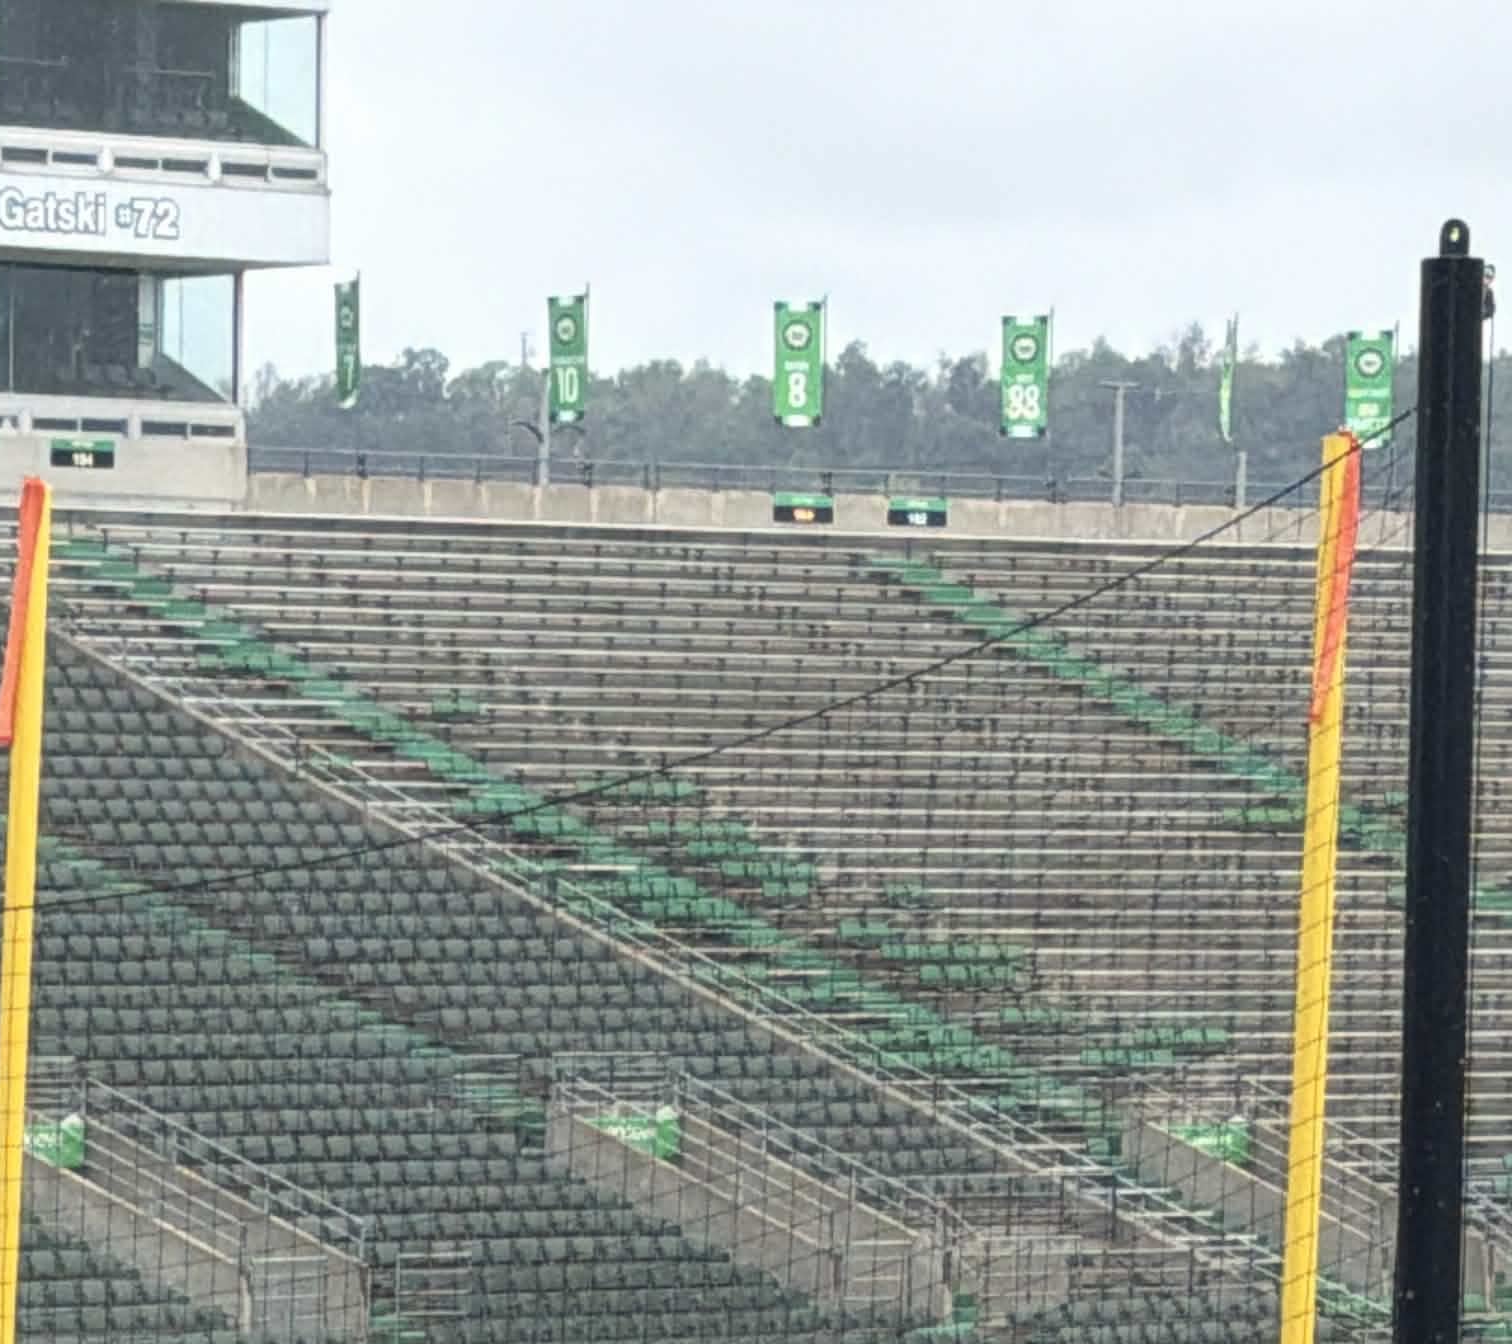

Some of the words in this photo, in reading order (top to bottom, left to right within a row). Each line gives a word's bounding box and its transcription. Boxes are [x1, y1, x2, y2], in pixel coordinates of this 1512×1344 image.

[115, 196, 180, 240] #72
[555, 366, 579, 404] 10
[788, 373, 807, 408] 8
[1005, 384, 1041, 419] 88
